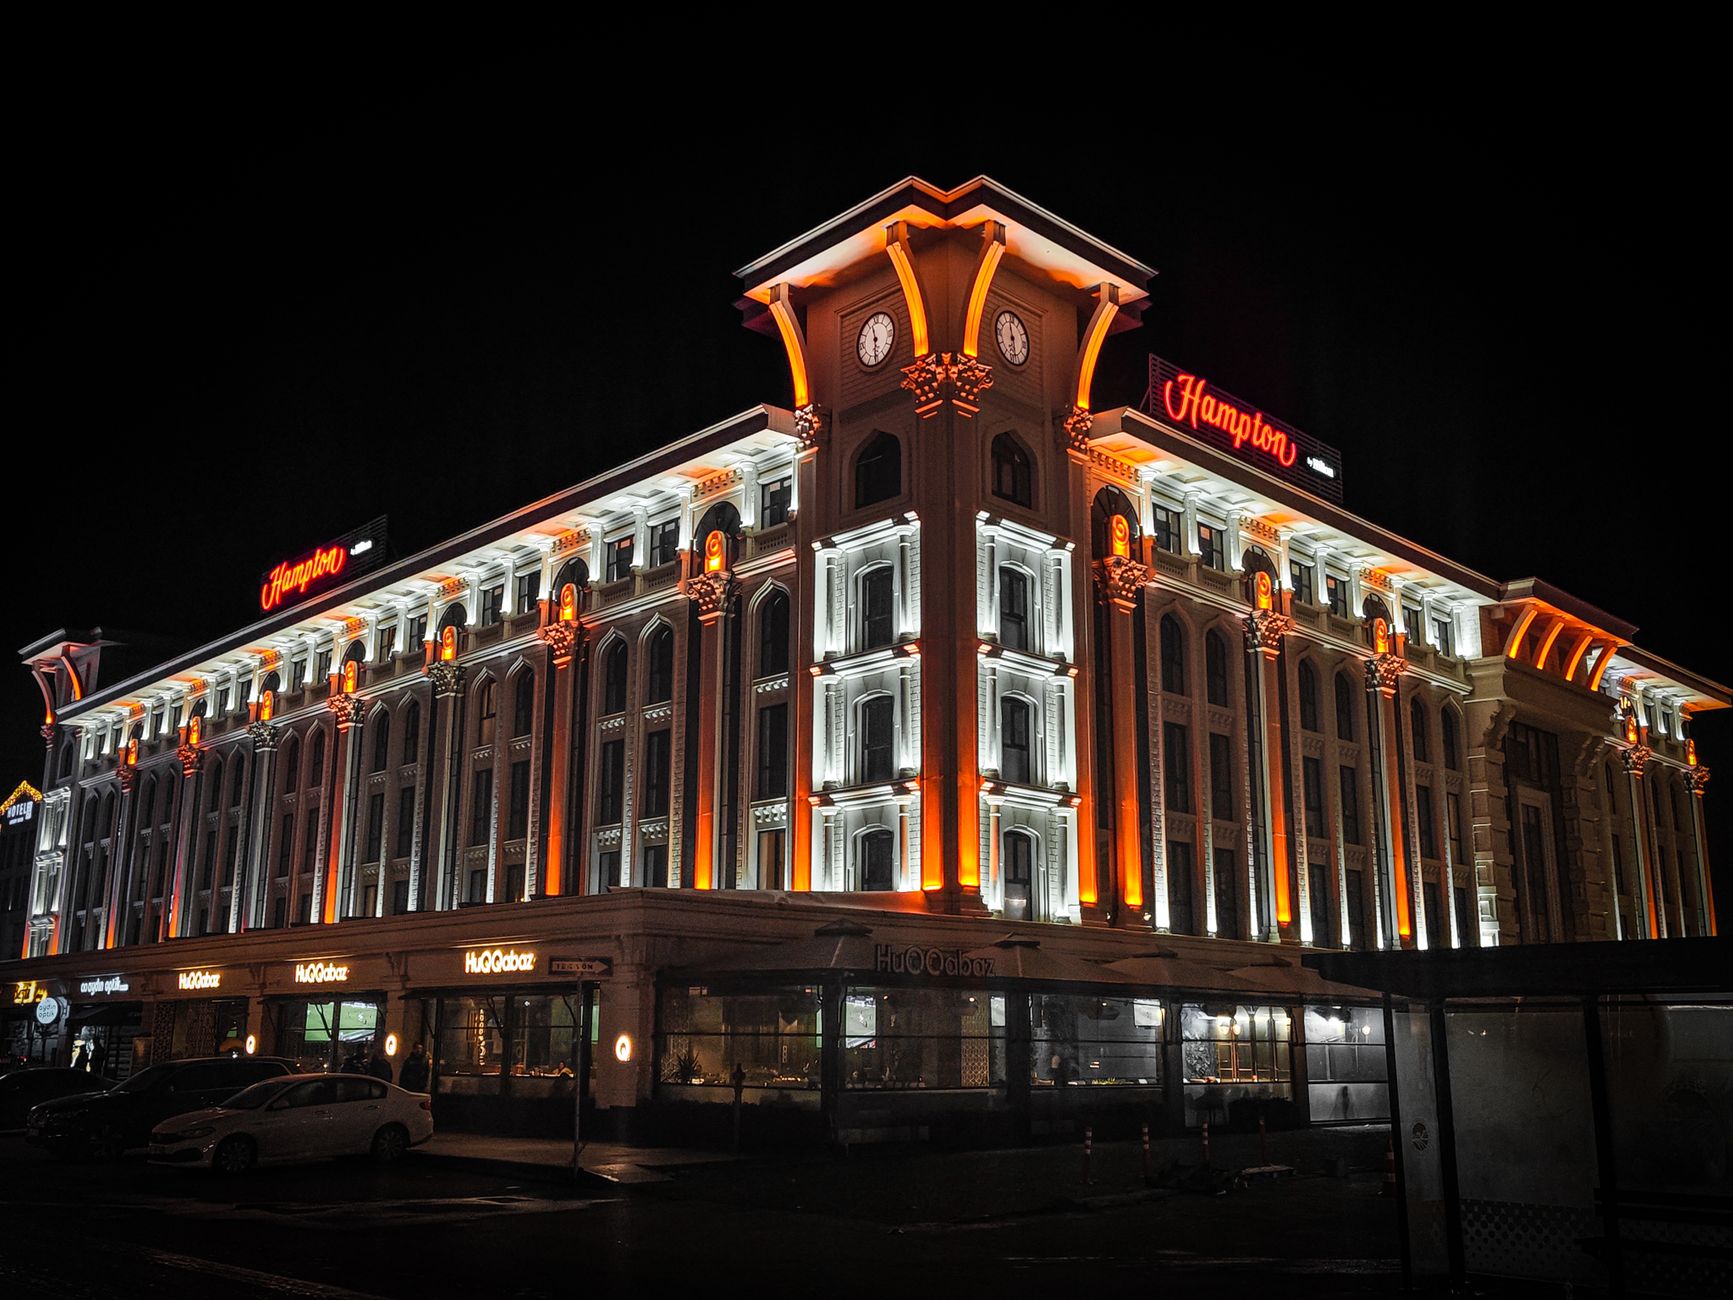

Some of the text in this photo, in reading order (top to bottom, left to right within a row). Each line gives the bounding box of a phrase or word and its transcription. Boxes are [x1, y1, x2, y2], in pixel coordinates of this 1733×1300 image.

[1164, 373, 1297, 468] Hampton
[261, 545, 346, 611] Hampton
[294, 962, 350, 984] HuQQabaz
[463, 949, 536, 974] HuQQabaz
[874, 943, 996, 977] HuQQabaz
